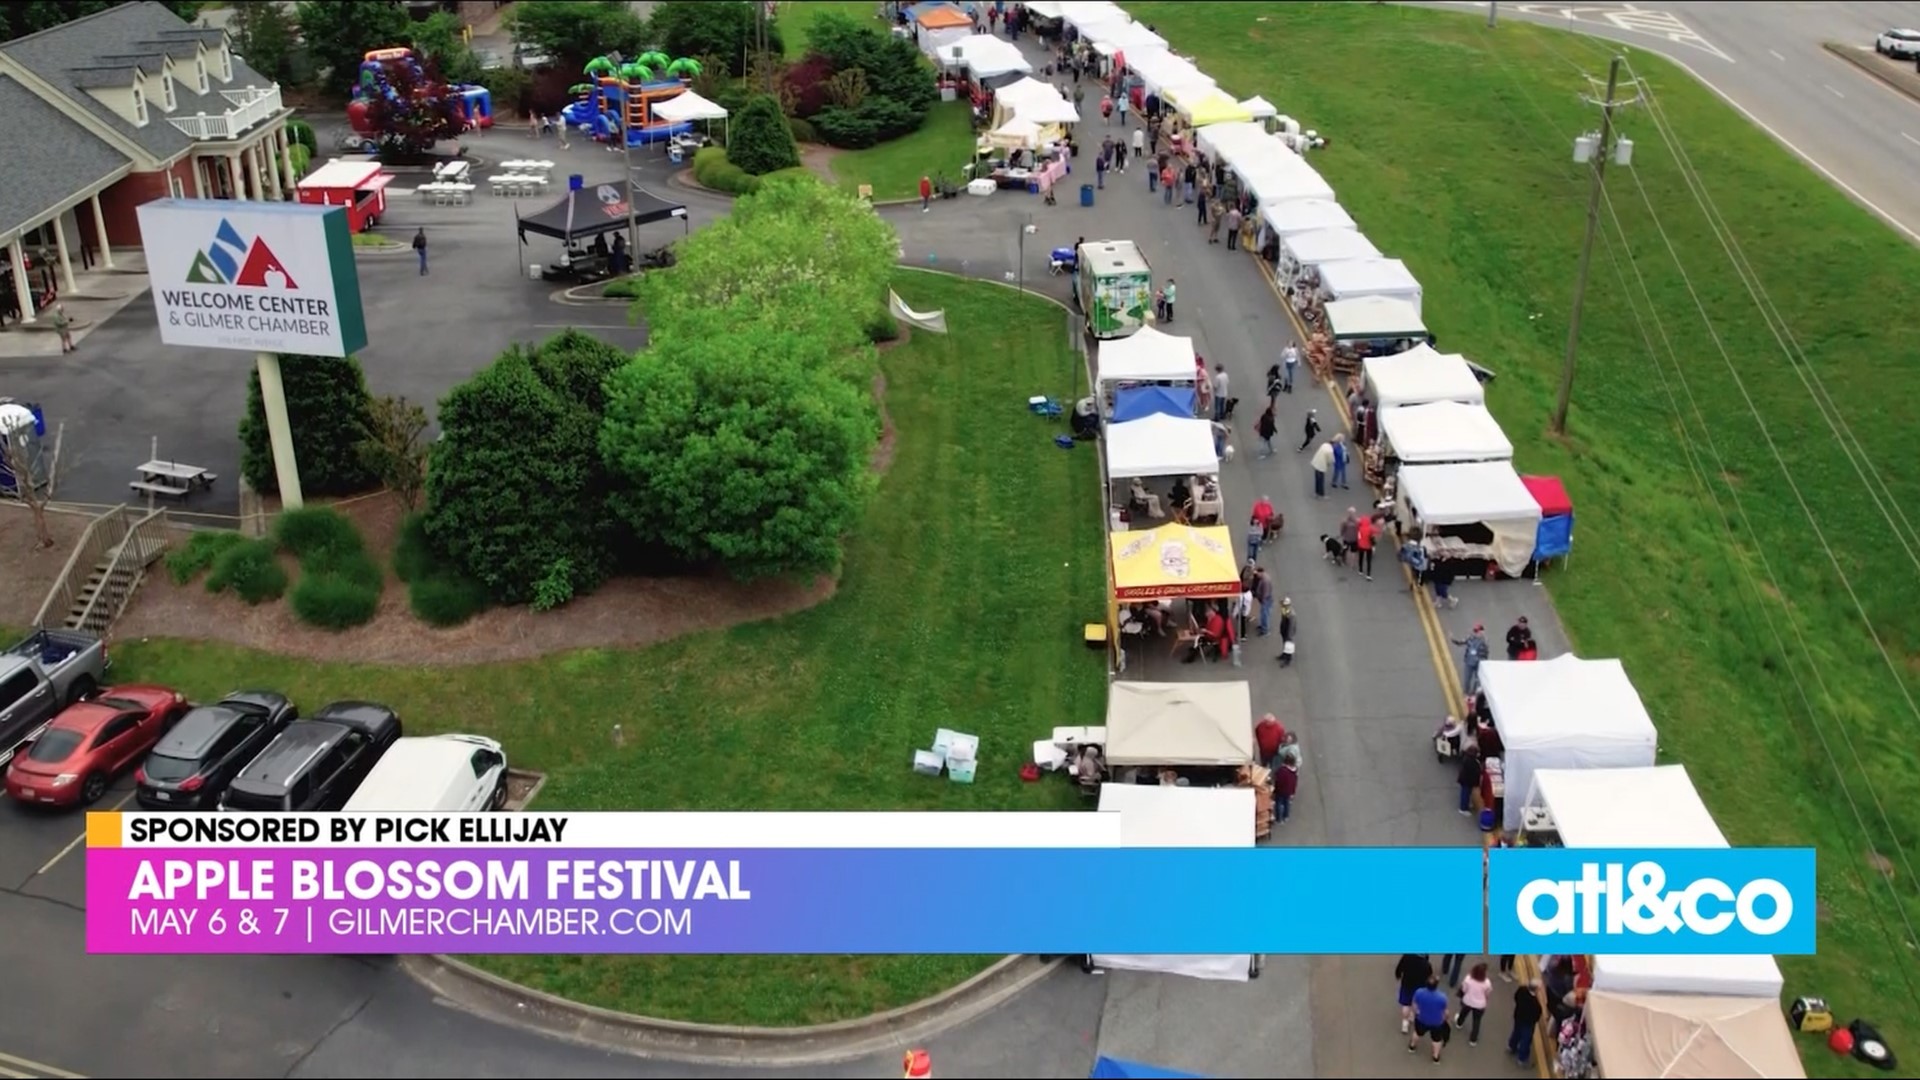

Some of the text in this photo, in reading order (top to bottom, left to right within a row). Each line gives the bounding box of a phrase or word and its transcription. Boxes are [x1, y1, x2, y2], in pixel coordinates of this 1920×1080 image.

[162, 289, 330, 316] WELCOME CENTER
[169, 311, 331, 336] & GILMER CHAMBER
